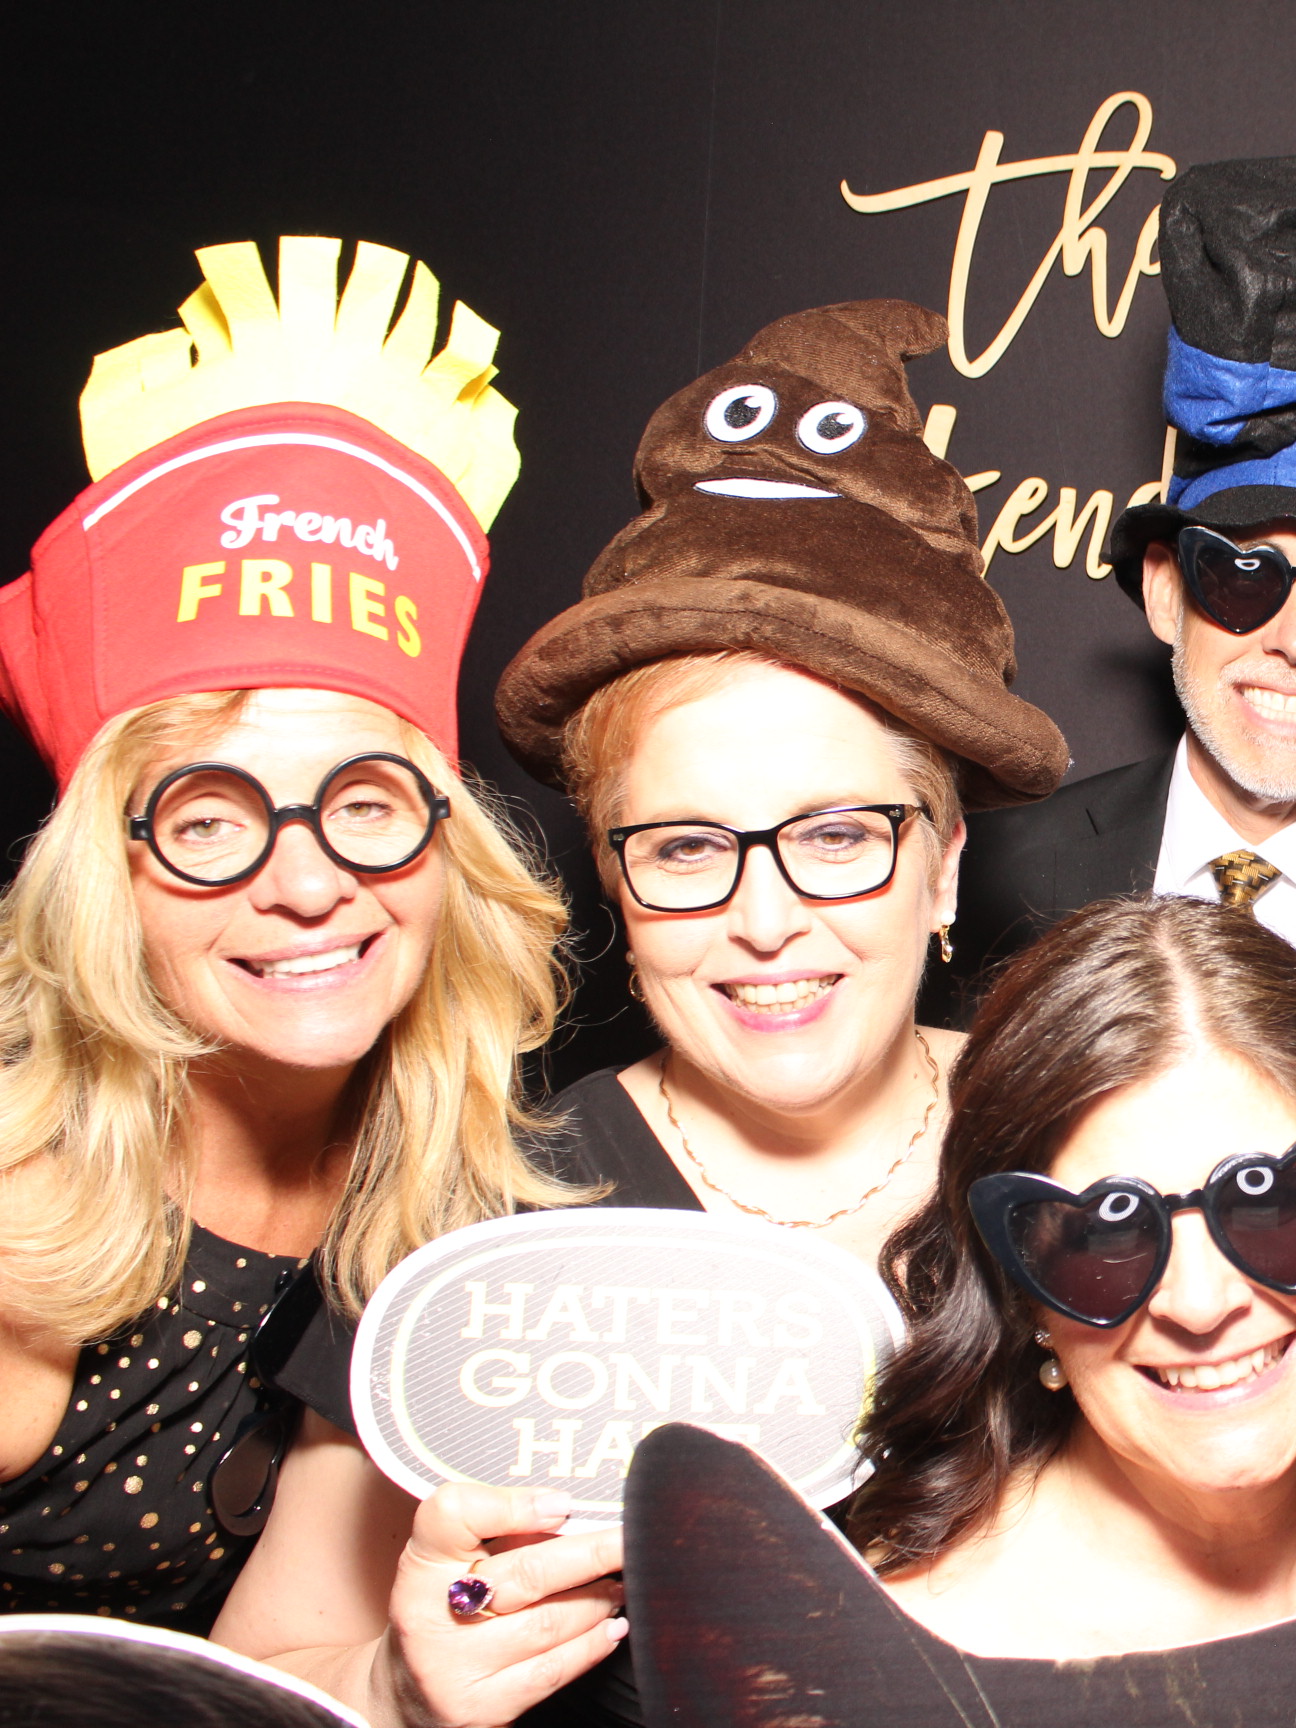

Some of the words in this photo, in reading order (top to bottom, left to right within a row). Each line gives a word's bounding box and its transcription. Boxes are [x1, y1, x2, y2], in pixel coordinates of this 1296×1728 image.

[220, 494, 399, 571] French
[177, 558, 422, 658] FRIES
[460, 1281, 824, 1348] HATERS
[459, 1348, 827, 1415] GONNA
[508, 1417, 761, 1478] HA
